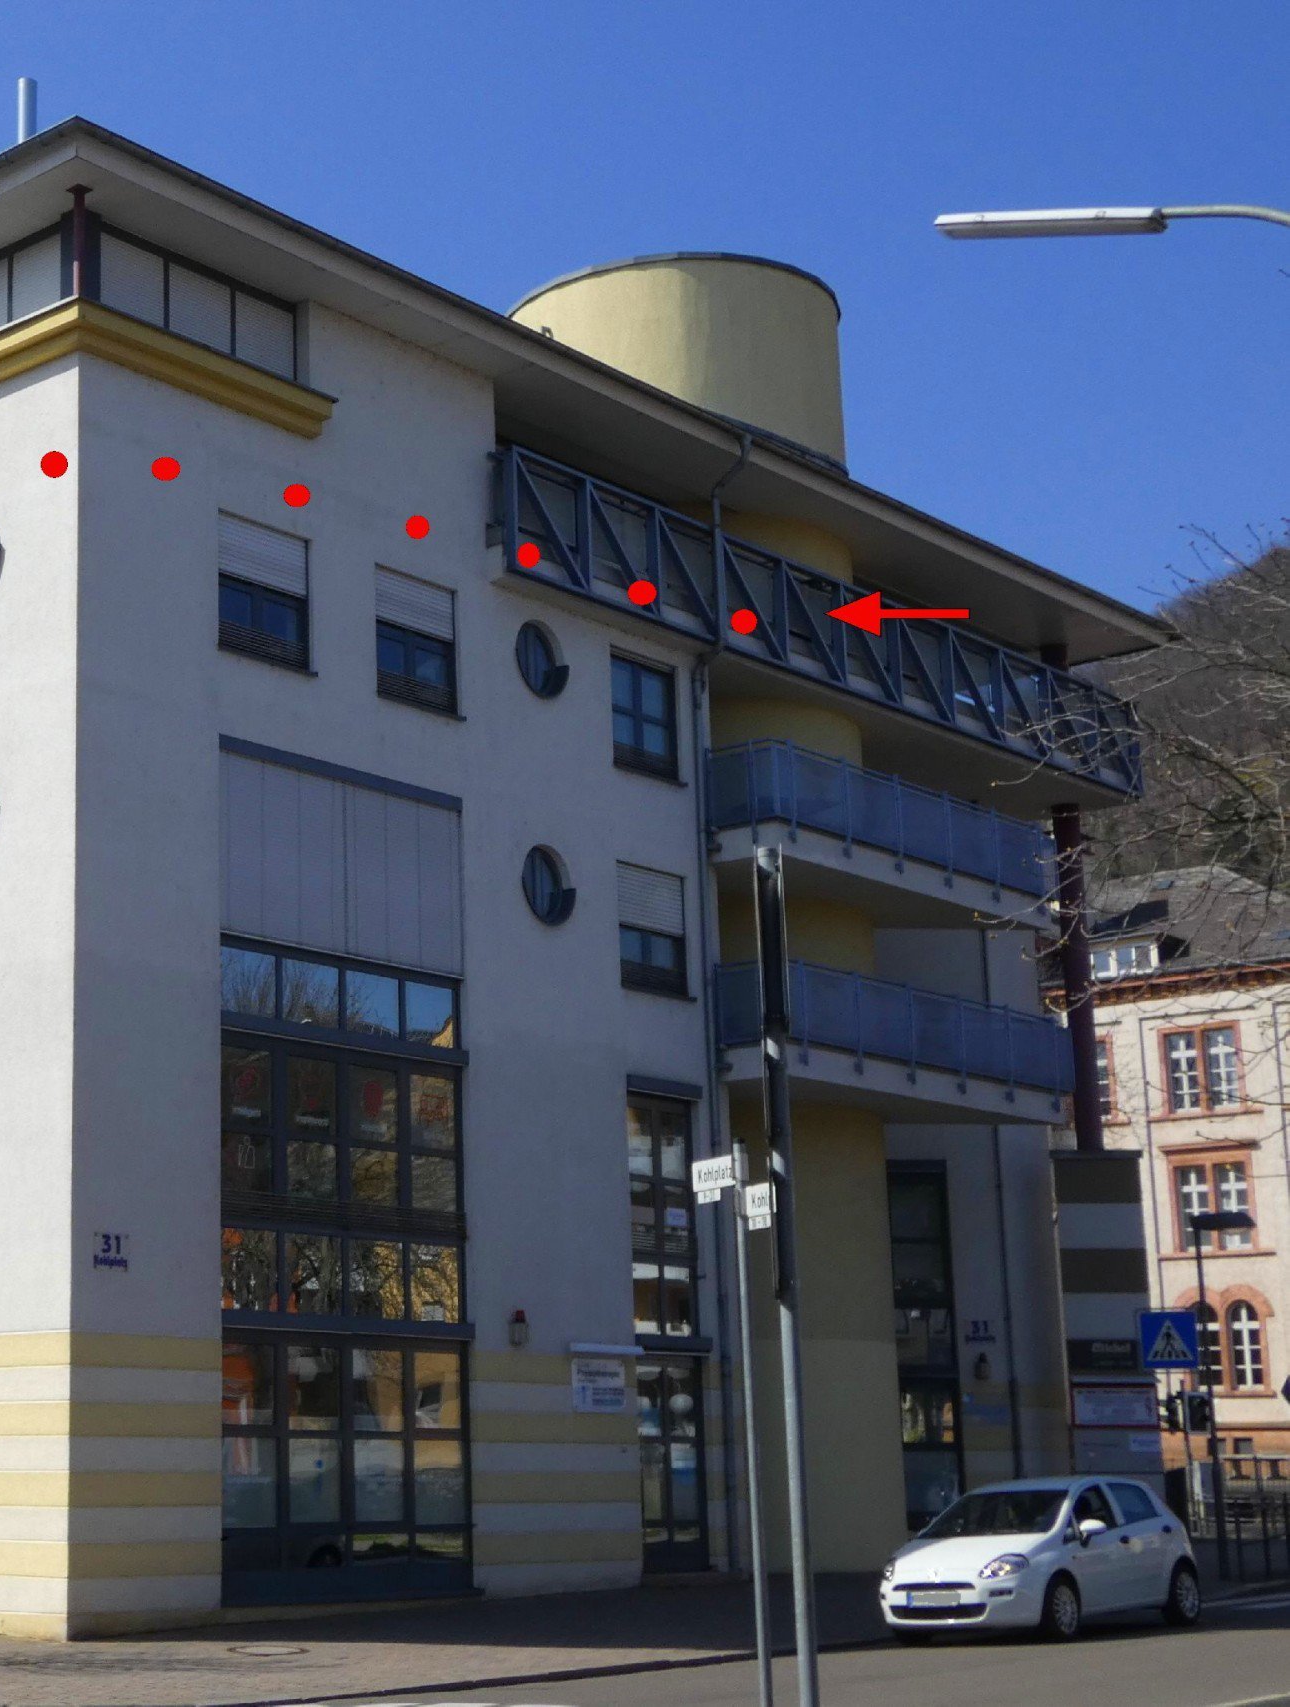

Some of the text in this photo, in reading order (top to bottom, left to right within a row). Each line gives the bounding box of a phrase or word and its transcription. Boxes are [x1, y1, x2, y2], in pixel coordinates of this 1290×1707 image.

[697, 1165, 733, 1184] Kohlplatz
[751, 1191, 769, 1209] Kohl
[101, 1233, 121, 1255] 31
